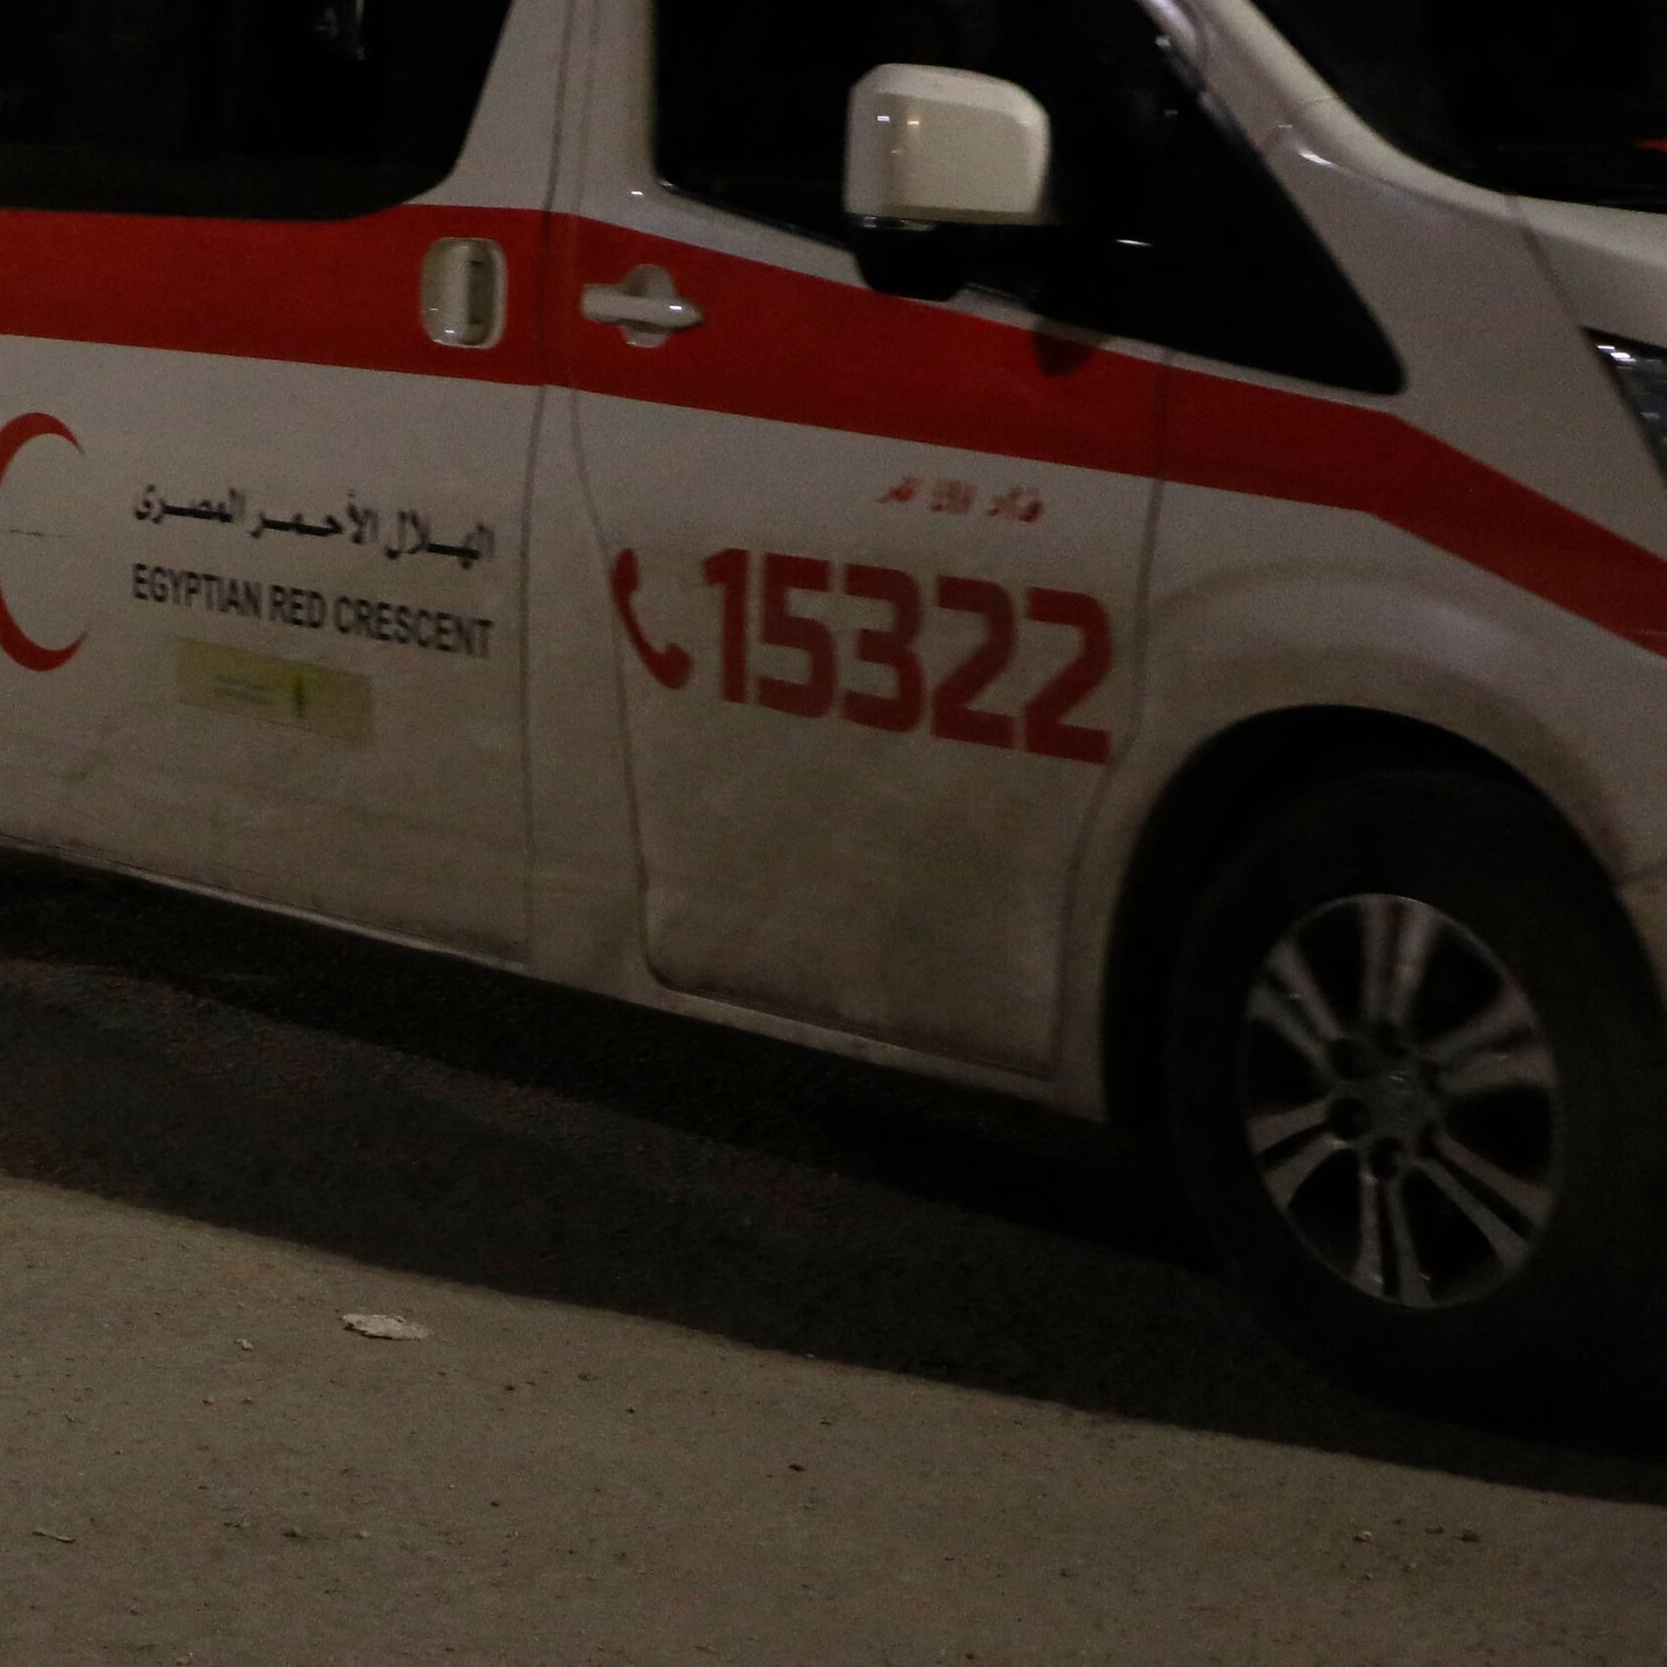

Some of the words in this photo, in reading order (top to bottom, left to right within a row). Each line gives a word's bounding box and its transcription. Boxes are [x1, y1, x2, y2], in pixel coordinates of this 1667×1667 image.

[384, 510, 496, 571] الهلال
[132, 561, 263, 621] EGYPTIAN
[268, 583, 329, 631] RED
[334, 595, 496, 660] CRESCENT
[702, 547, 1113, 765] 15322
